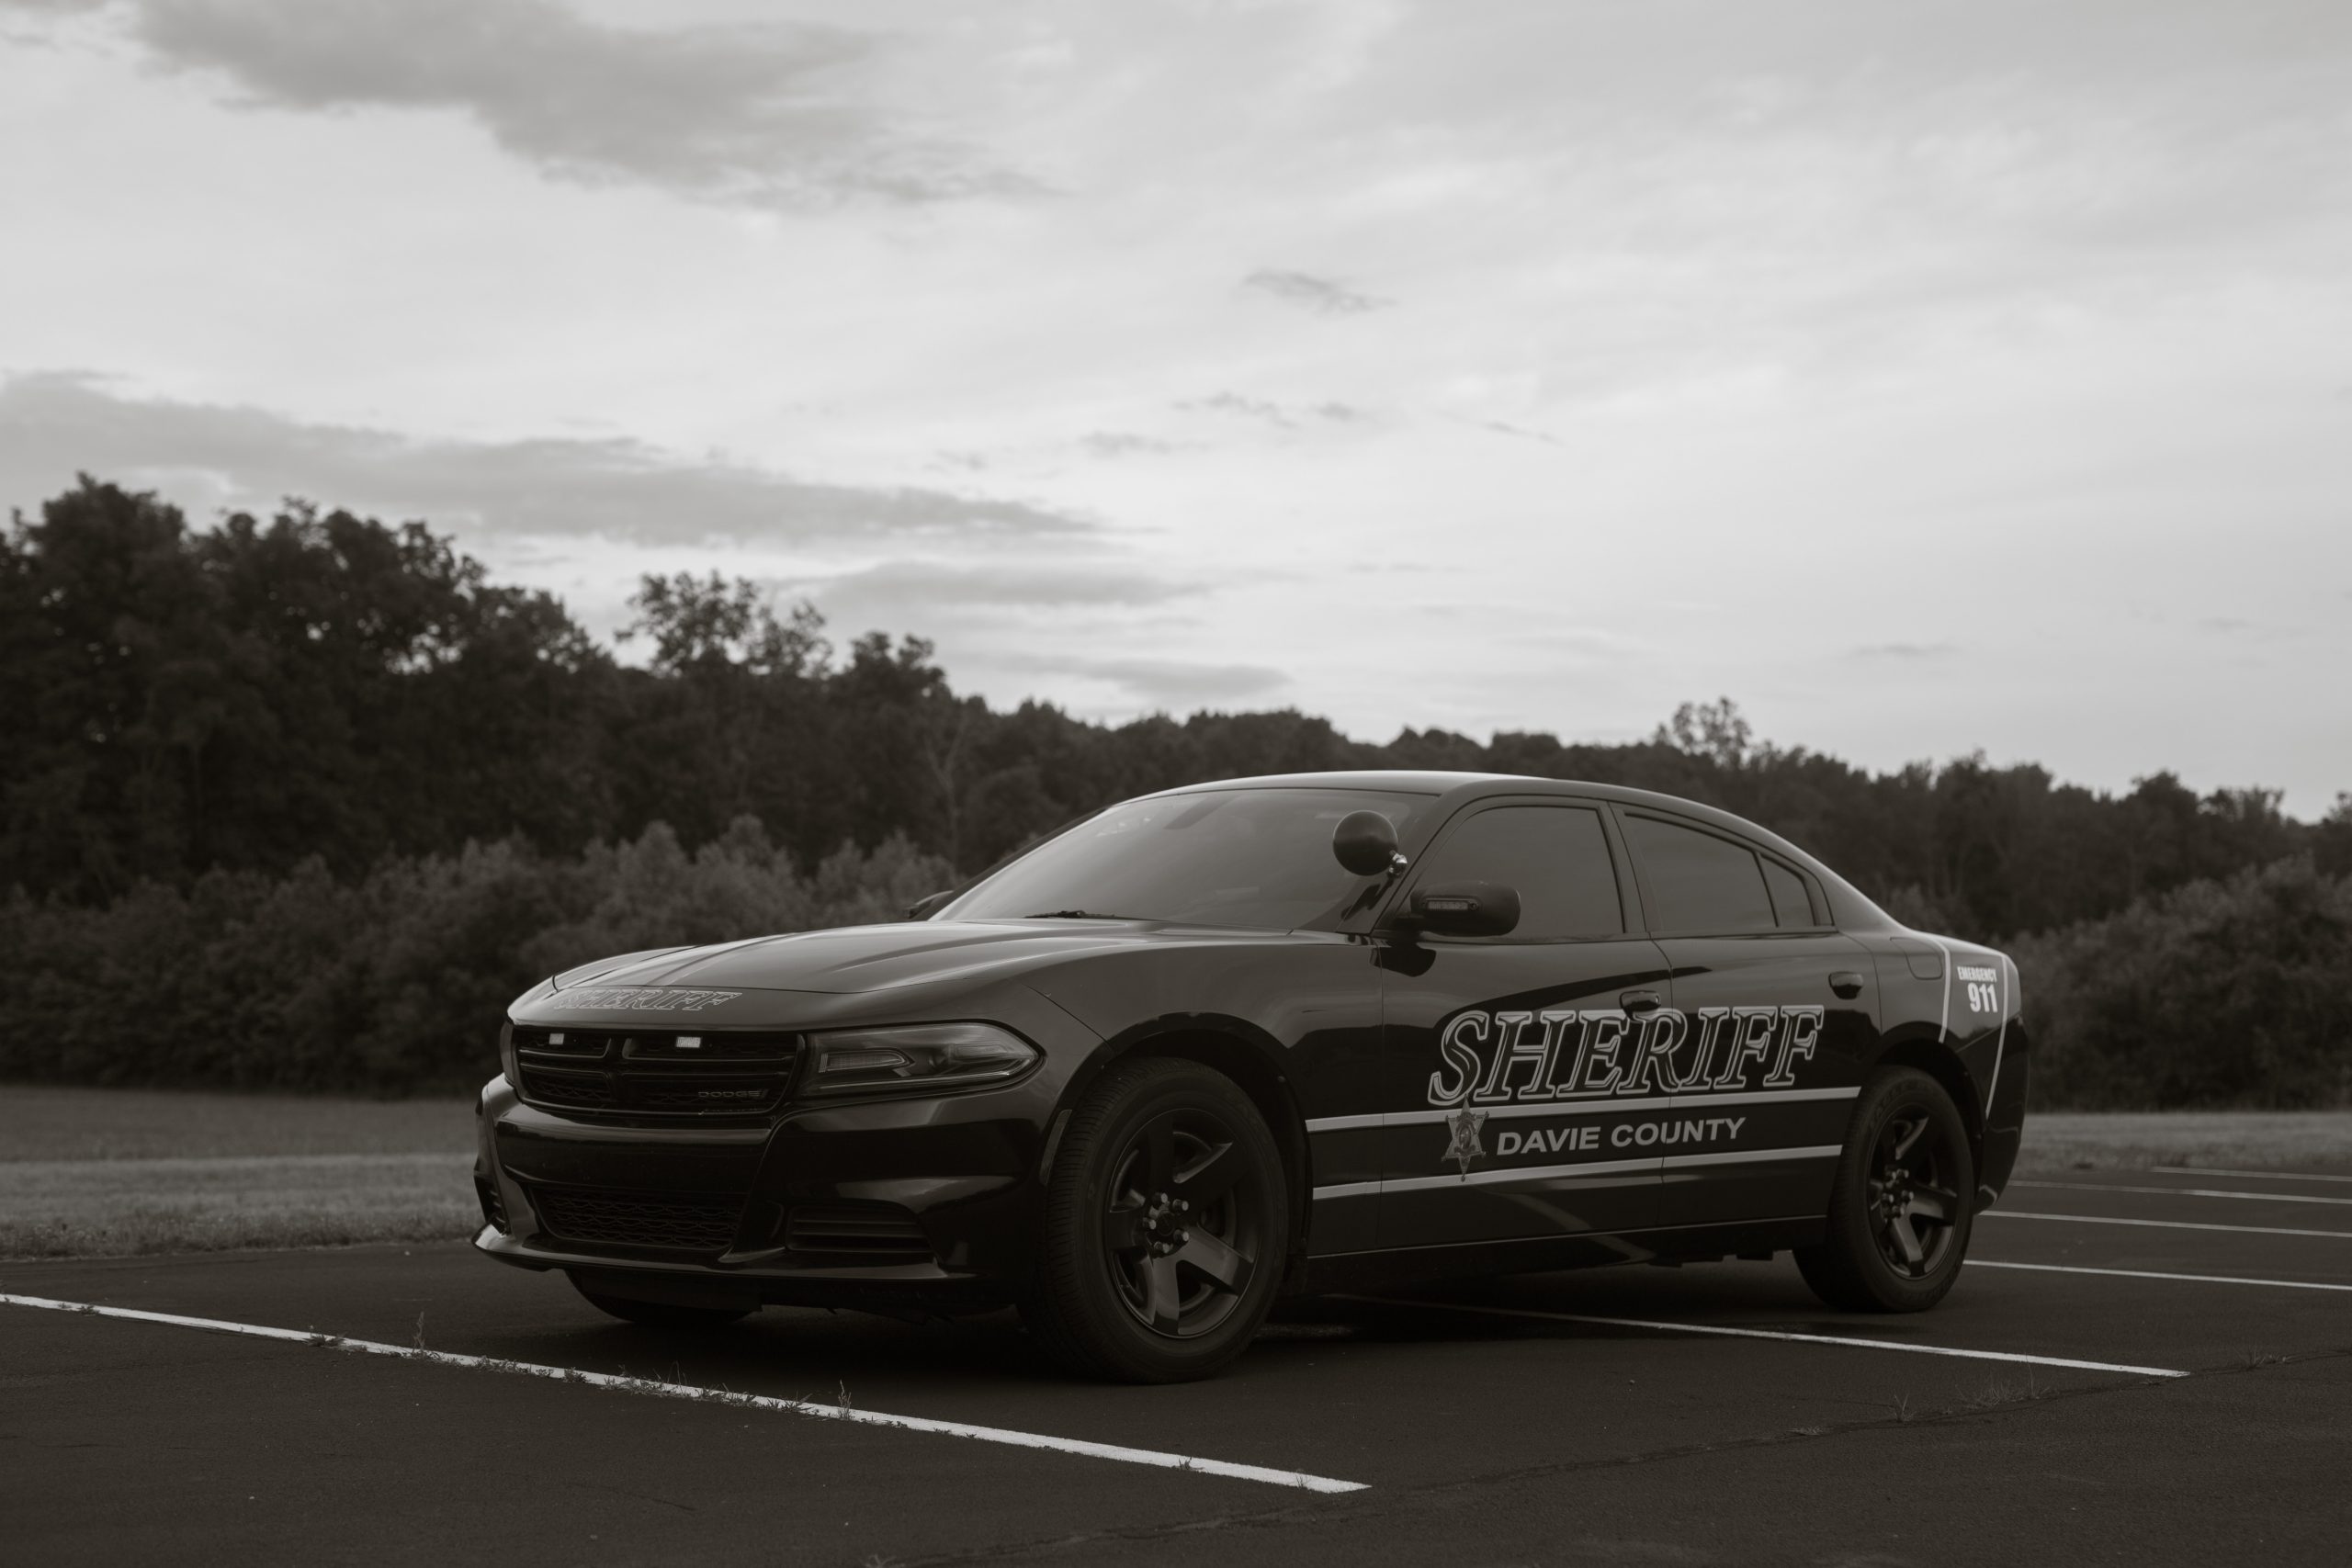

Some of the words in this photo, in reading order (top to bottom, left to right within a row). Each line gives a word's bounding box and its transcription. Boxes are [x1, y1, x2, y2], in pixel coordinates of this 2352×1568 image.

[554, 988, 743, 1011] SHERIFF
[1967, 982, 1998, 1013] 911
[1427, 1004, 1826, 1107] SHERIFF
[697, 1090, 761, 1099] DODGE
[1497, 1127, 1600, 1156] DAVIE
[1611, 1118, 1747, 1148] COUNTY
